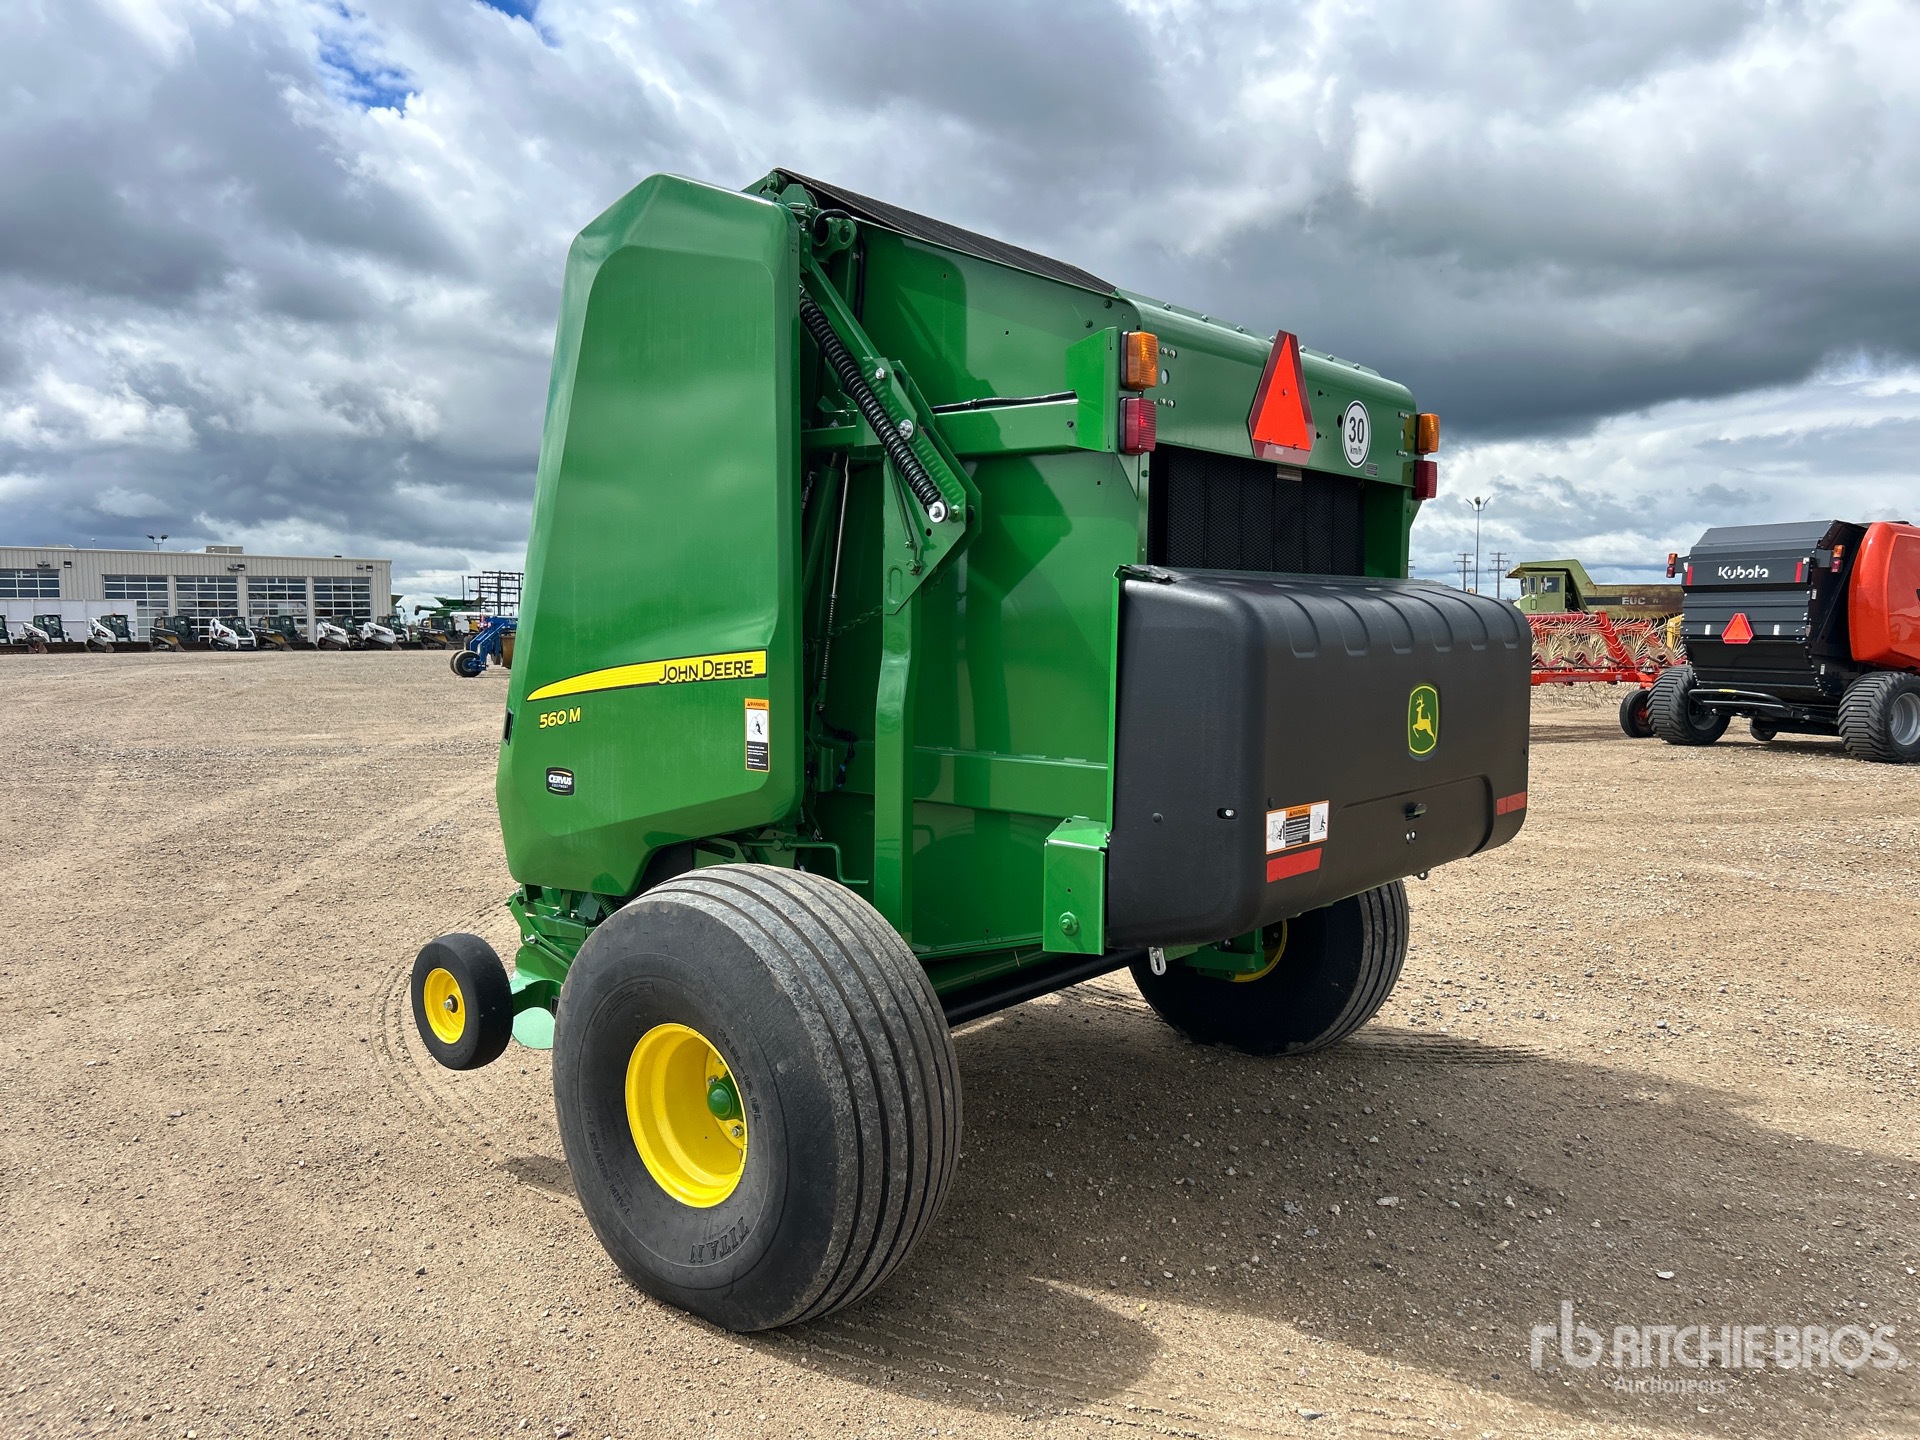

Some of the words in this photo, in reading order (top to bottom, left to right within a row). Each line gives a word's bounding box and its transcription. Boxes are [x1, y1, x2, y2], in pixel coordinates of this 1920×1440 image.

[1348, 416, 1365, 444] 30
[1718, 565, 1769, 579] Kubota
[1621, 596, 1646, 605] EUC
[659, 664, 699, 682] JOHN
[702, 660, 753, 678] DEERE
[539, 710, 567, 729] 560
[569, 706, 581, 723] M
[548, 774, 573, 785] CERVUS
[688, 1215, 750, 1264] TITAN
